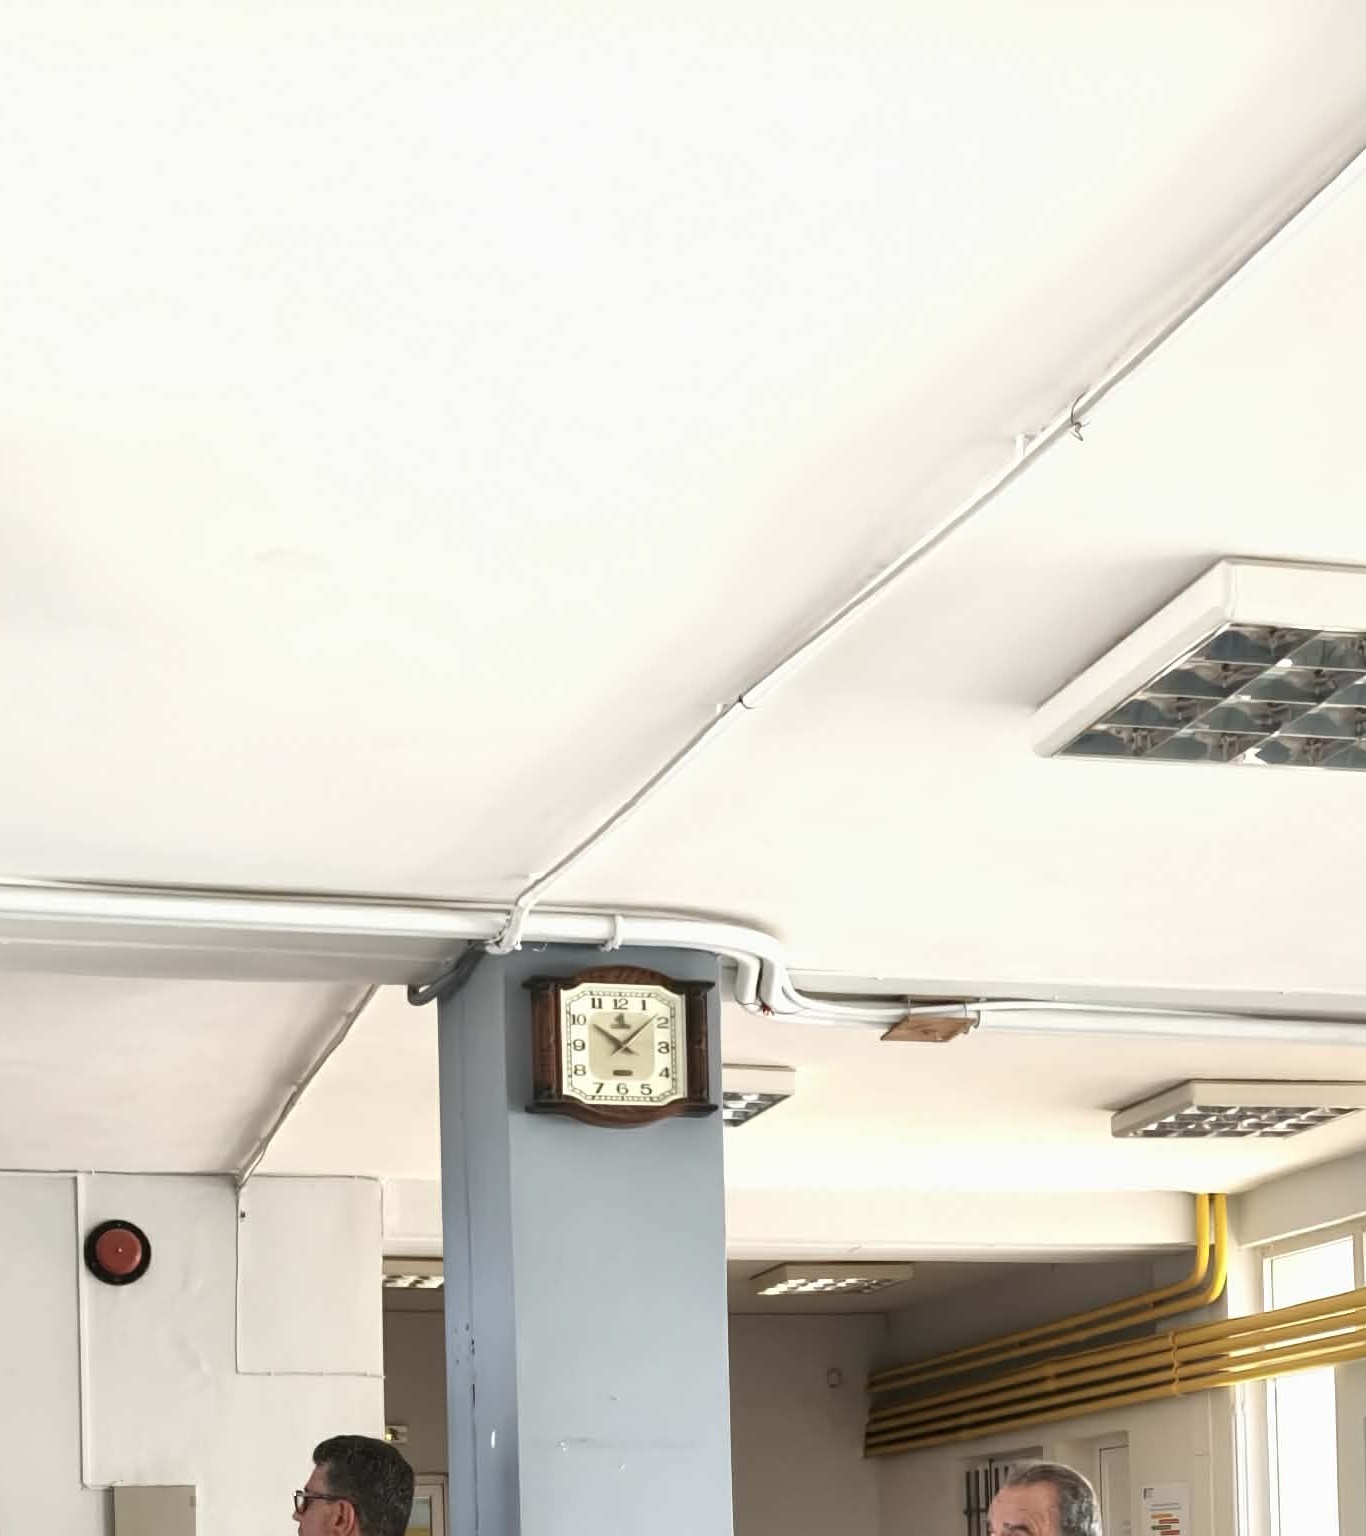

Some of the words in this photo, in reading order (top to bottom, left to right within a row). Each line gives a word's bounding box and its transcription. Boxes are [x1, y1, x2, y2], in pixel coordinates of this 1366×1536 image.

[591, 997, 604, 1010] 11
[613, 998, 629, 1010] 12
[571, 1014, 587, 1026] 10
[657, 1016, 670, 1029] 2
[572, 1039, 586, 1052] 9
[657, 1041, 670, 1055] 3
[573, 1065, 586, 1077] 8
[658, 1067, 670, 1079] 4
[594, 1082, 606, 1094] 7
[616, 1083, 629, 1096] 6
[640, 1084, 653, 1096] 5
